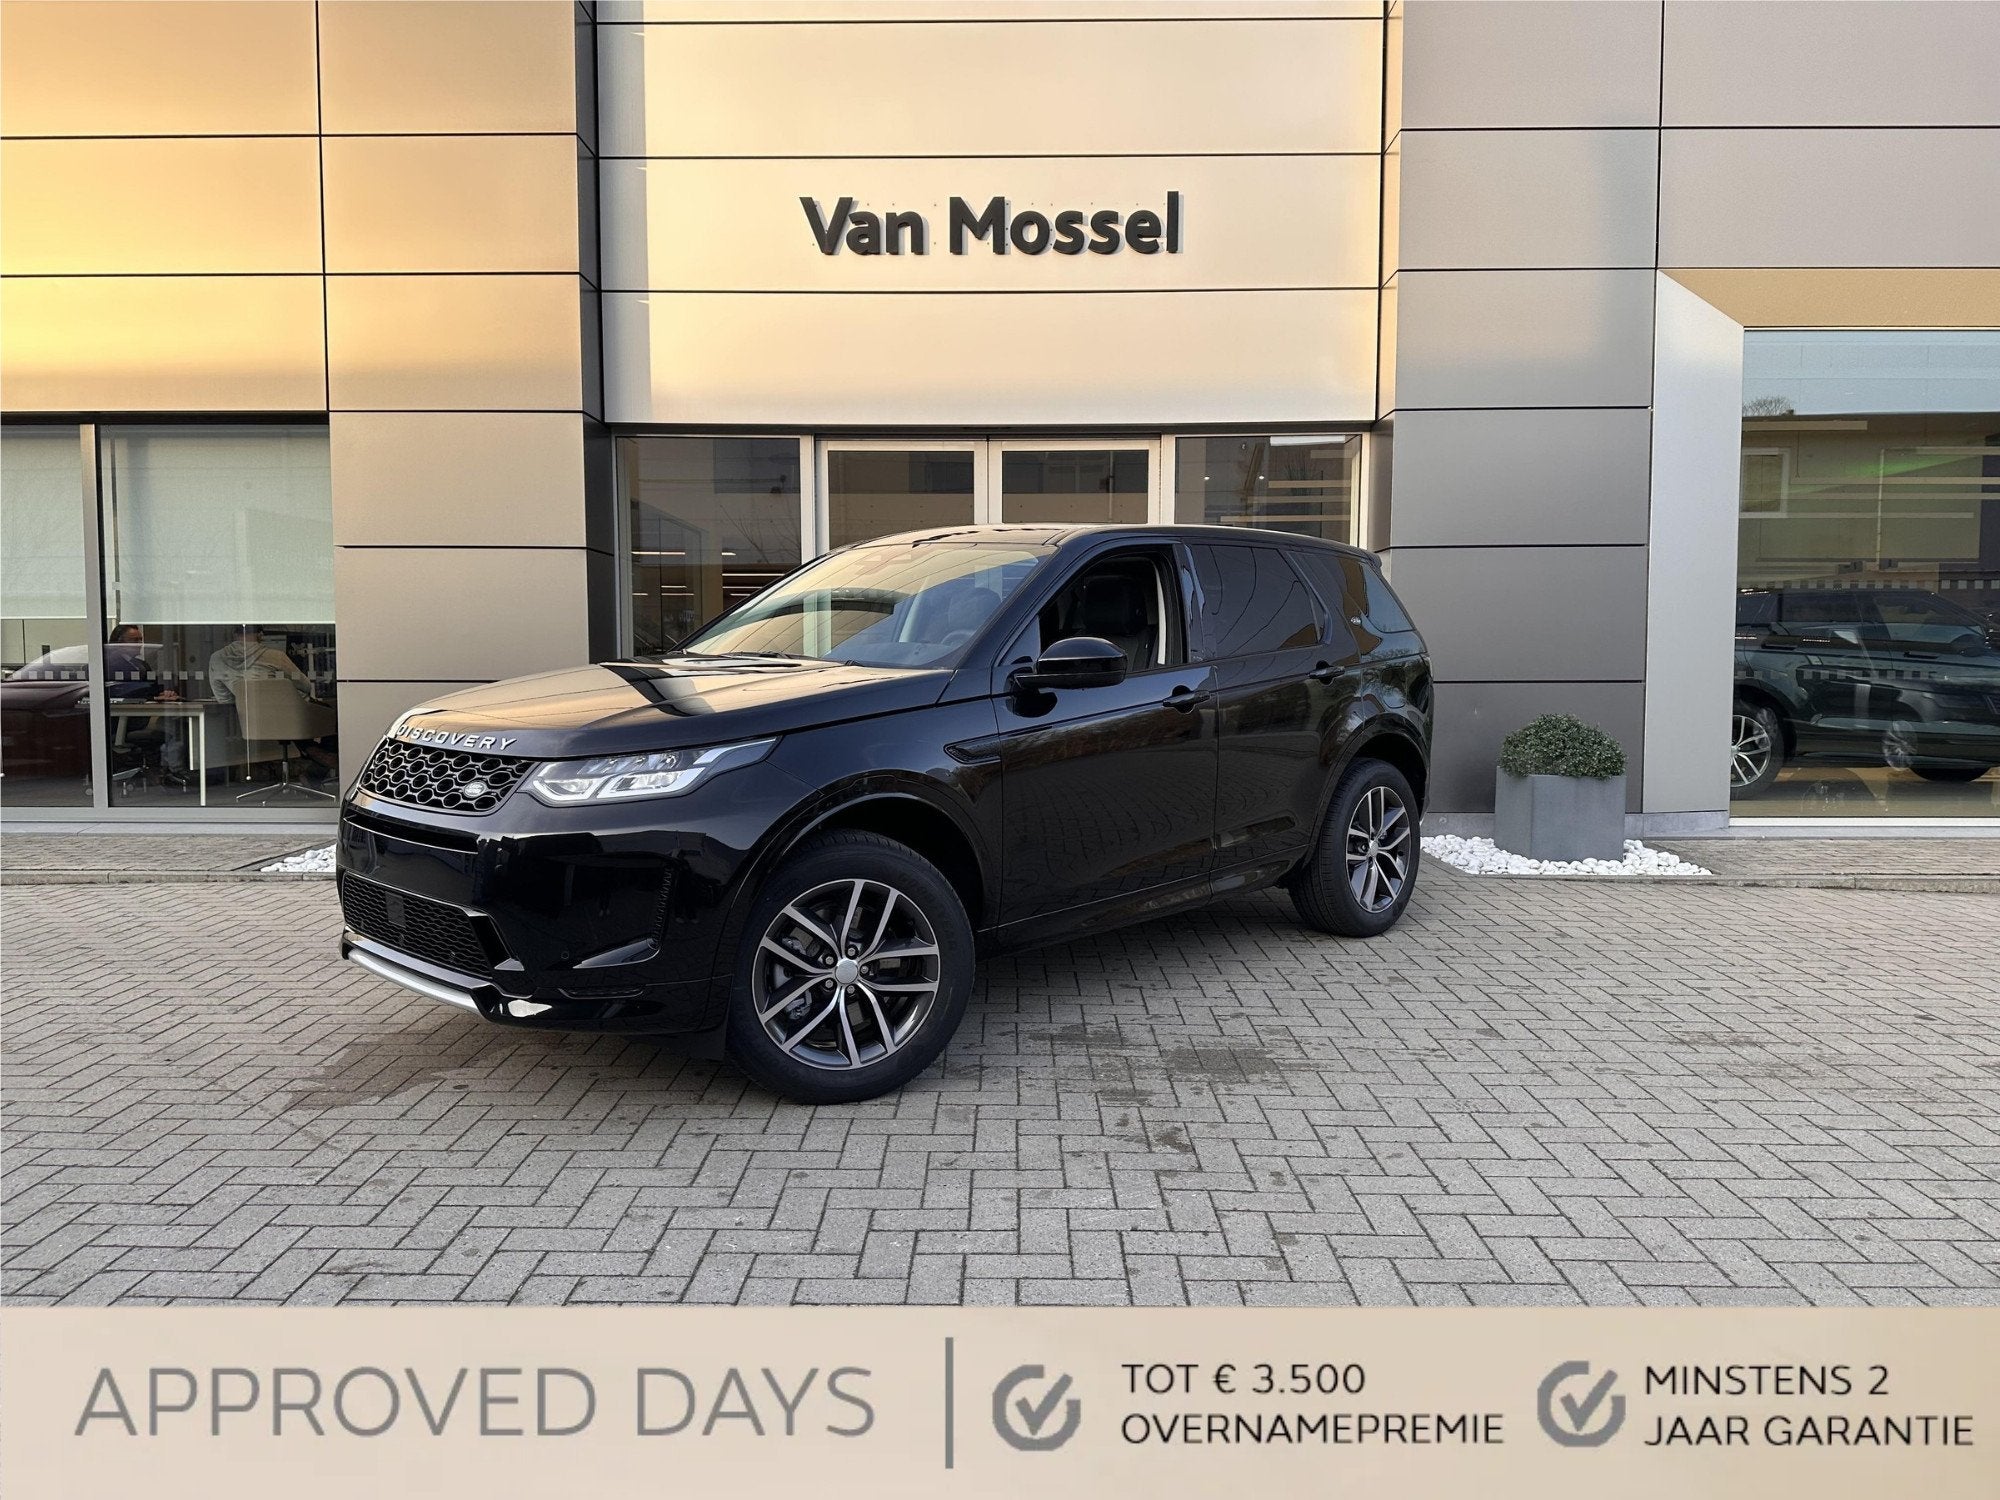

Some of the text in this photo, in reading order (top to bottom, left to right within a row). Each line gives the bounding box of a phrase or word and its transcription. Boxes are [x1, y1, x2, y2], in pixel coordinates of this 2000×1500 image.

[799, 190, 1180, 256] Van Mossel
[396, 724, 517, 751] DISCOVERY
